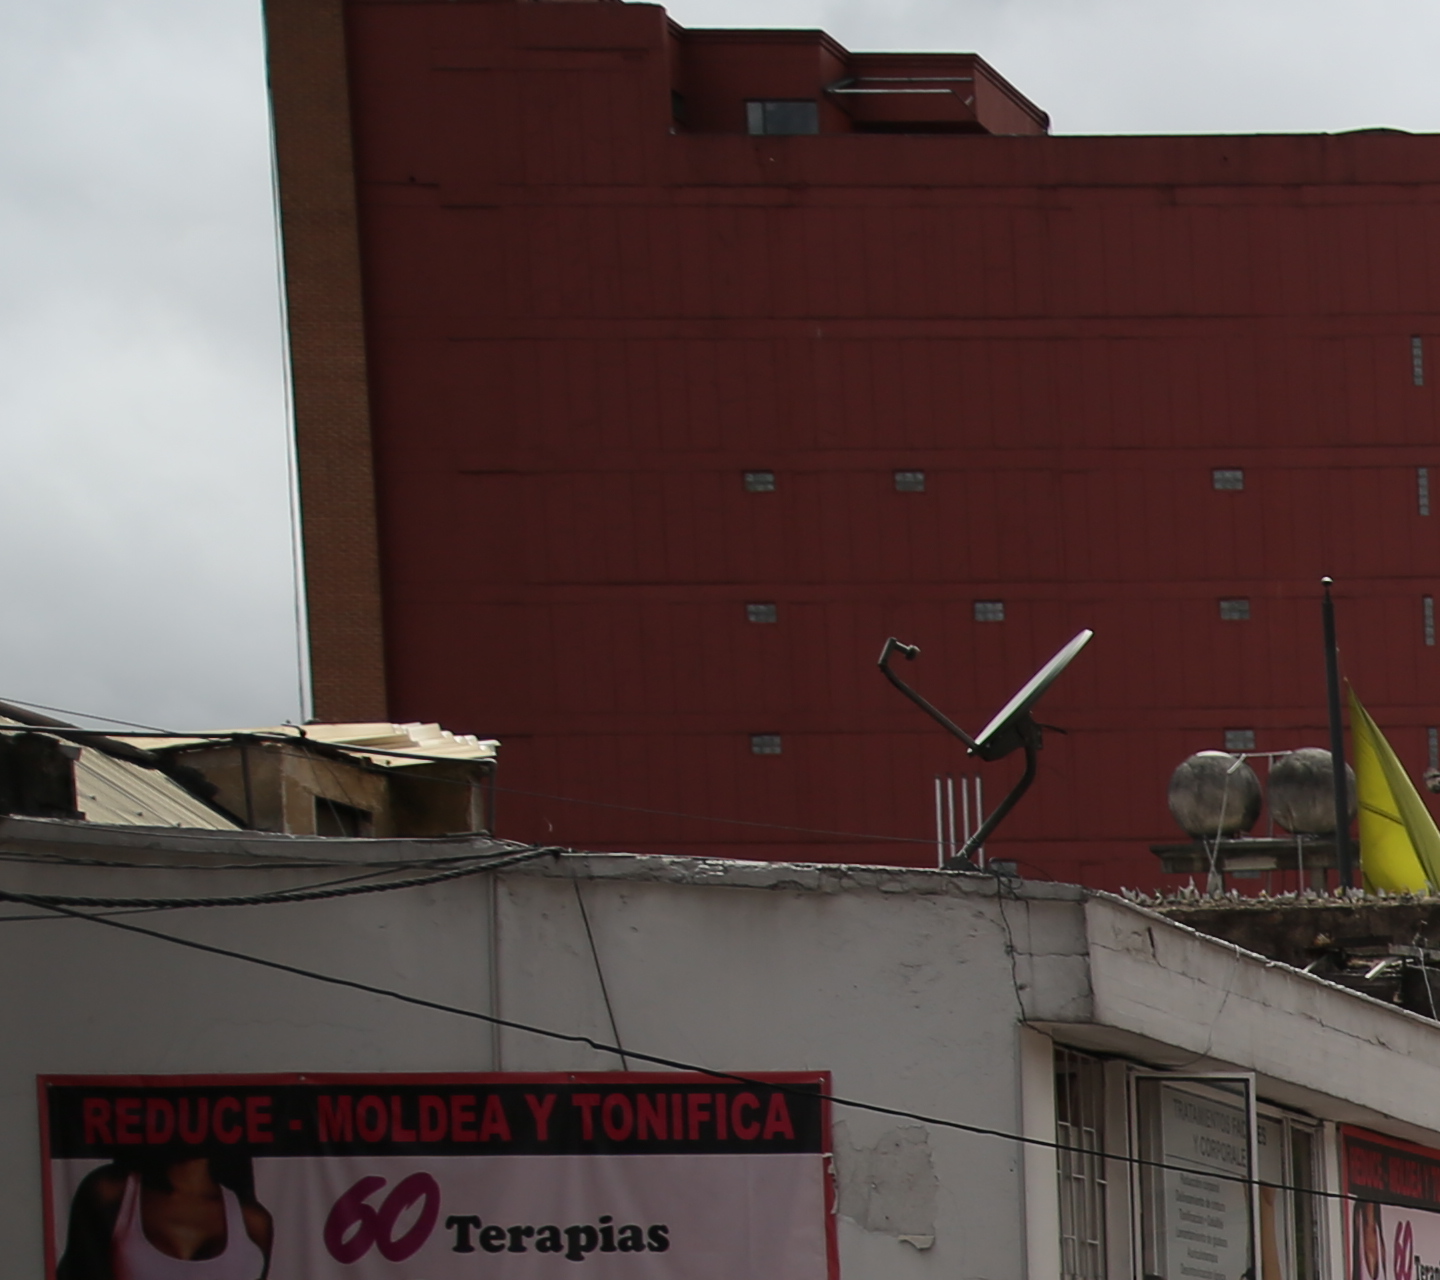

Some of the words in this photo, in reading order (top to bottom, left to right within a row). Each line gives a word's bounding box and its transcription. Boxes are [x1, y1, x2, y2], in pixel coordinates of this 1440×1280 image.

[83, 1095, 274, 1144] REDUCE
[317, 1093, 510, 1144] MOLDEA
[529, 1093, 560, 1141] Y
[573, 1092, 796, 1142] TONIFICA
[323, 1171, 441, 1265] 60
[446, 1214, 670, 1262] Terapias
